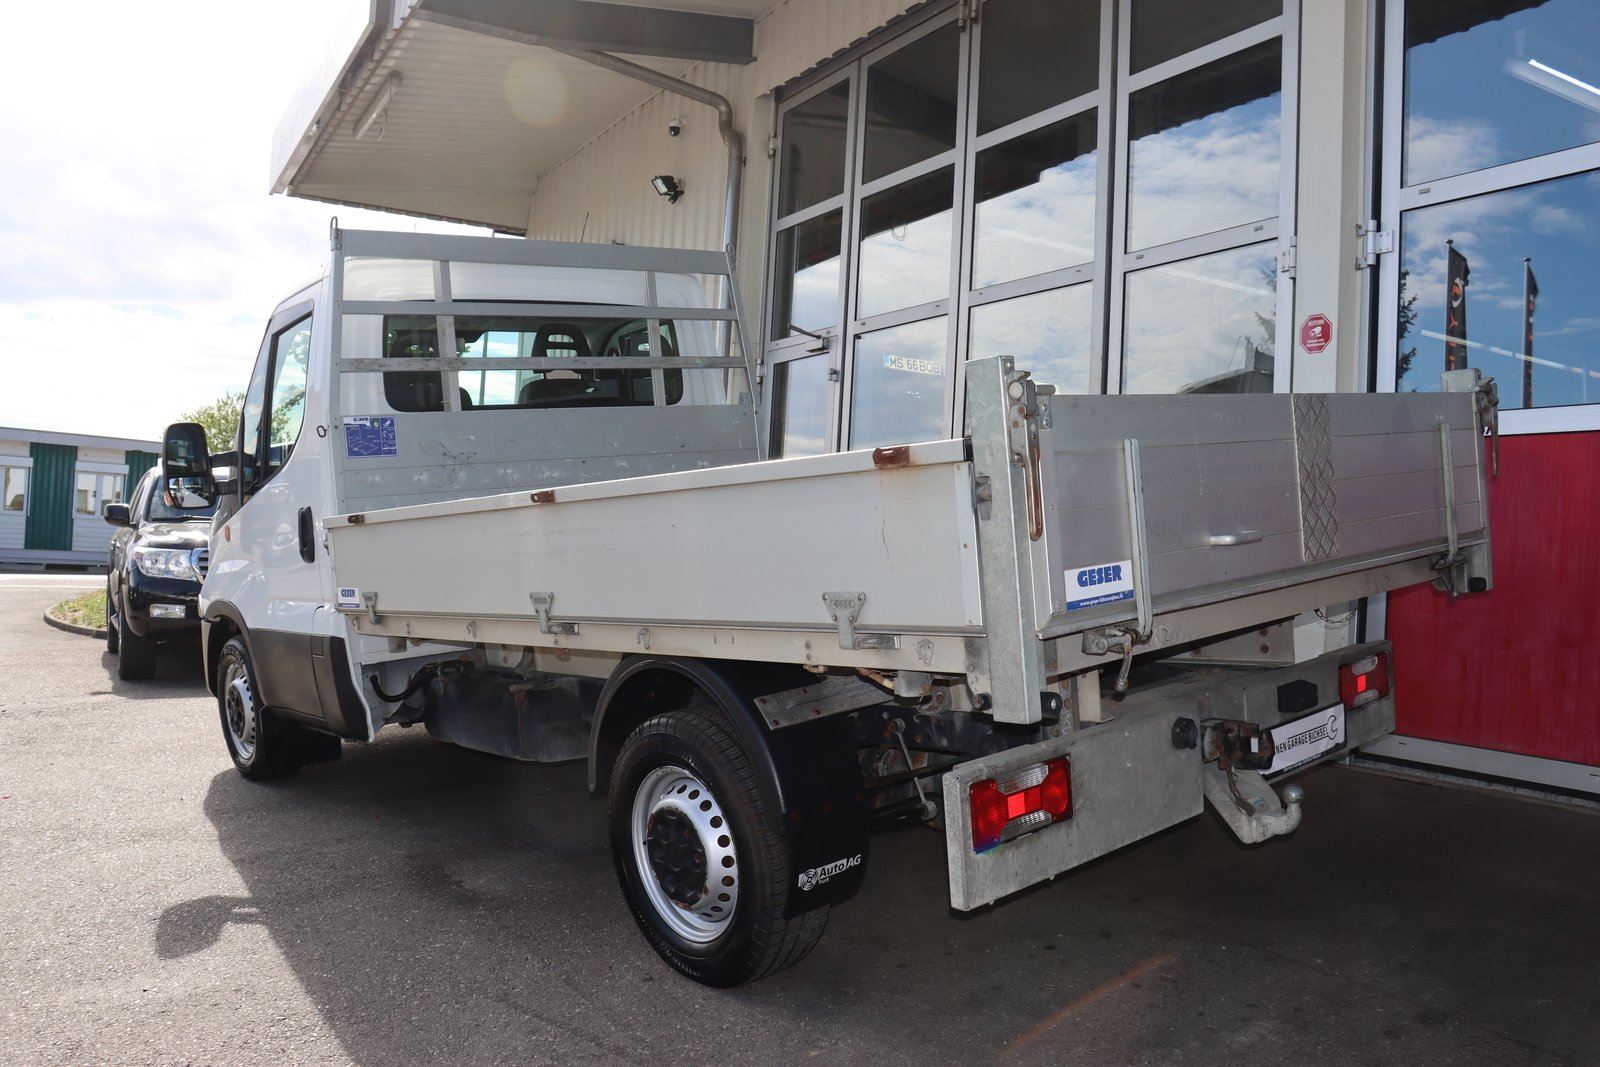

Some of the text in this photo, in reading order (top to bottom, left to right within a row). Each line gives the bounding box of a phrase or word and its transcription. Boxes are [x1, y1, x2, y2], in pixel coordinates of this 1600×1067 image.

[890, 357, 903, 368] MS
[1077, 565, 1122, 587] GESER
[341, 588, 356, 598] GESER
[1276, 726, 1328, 754] NEN GARAGE BICHSEL
[819, 855, 861, 877] Auto AG
